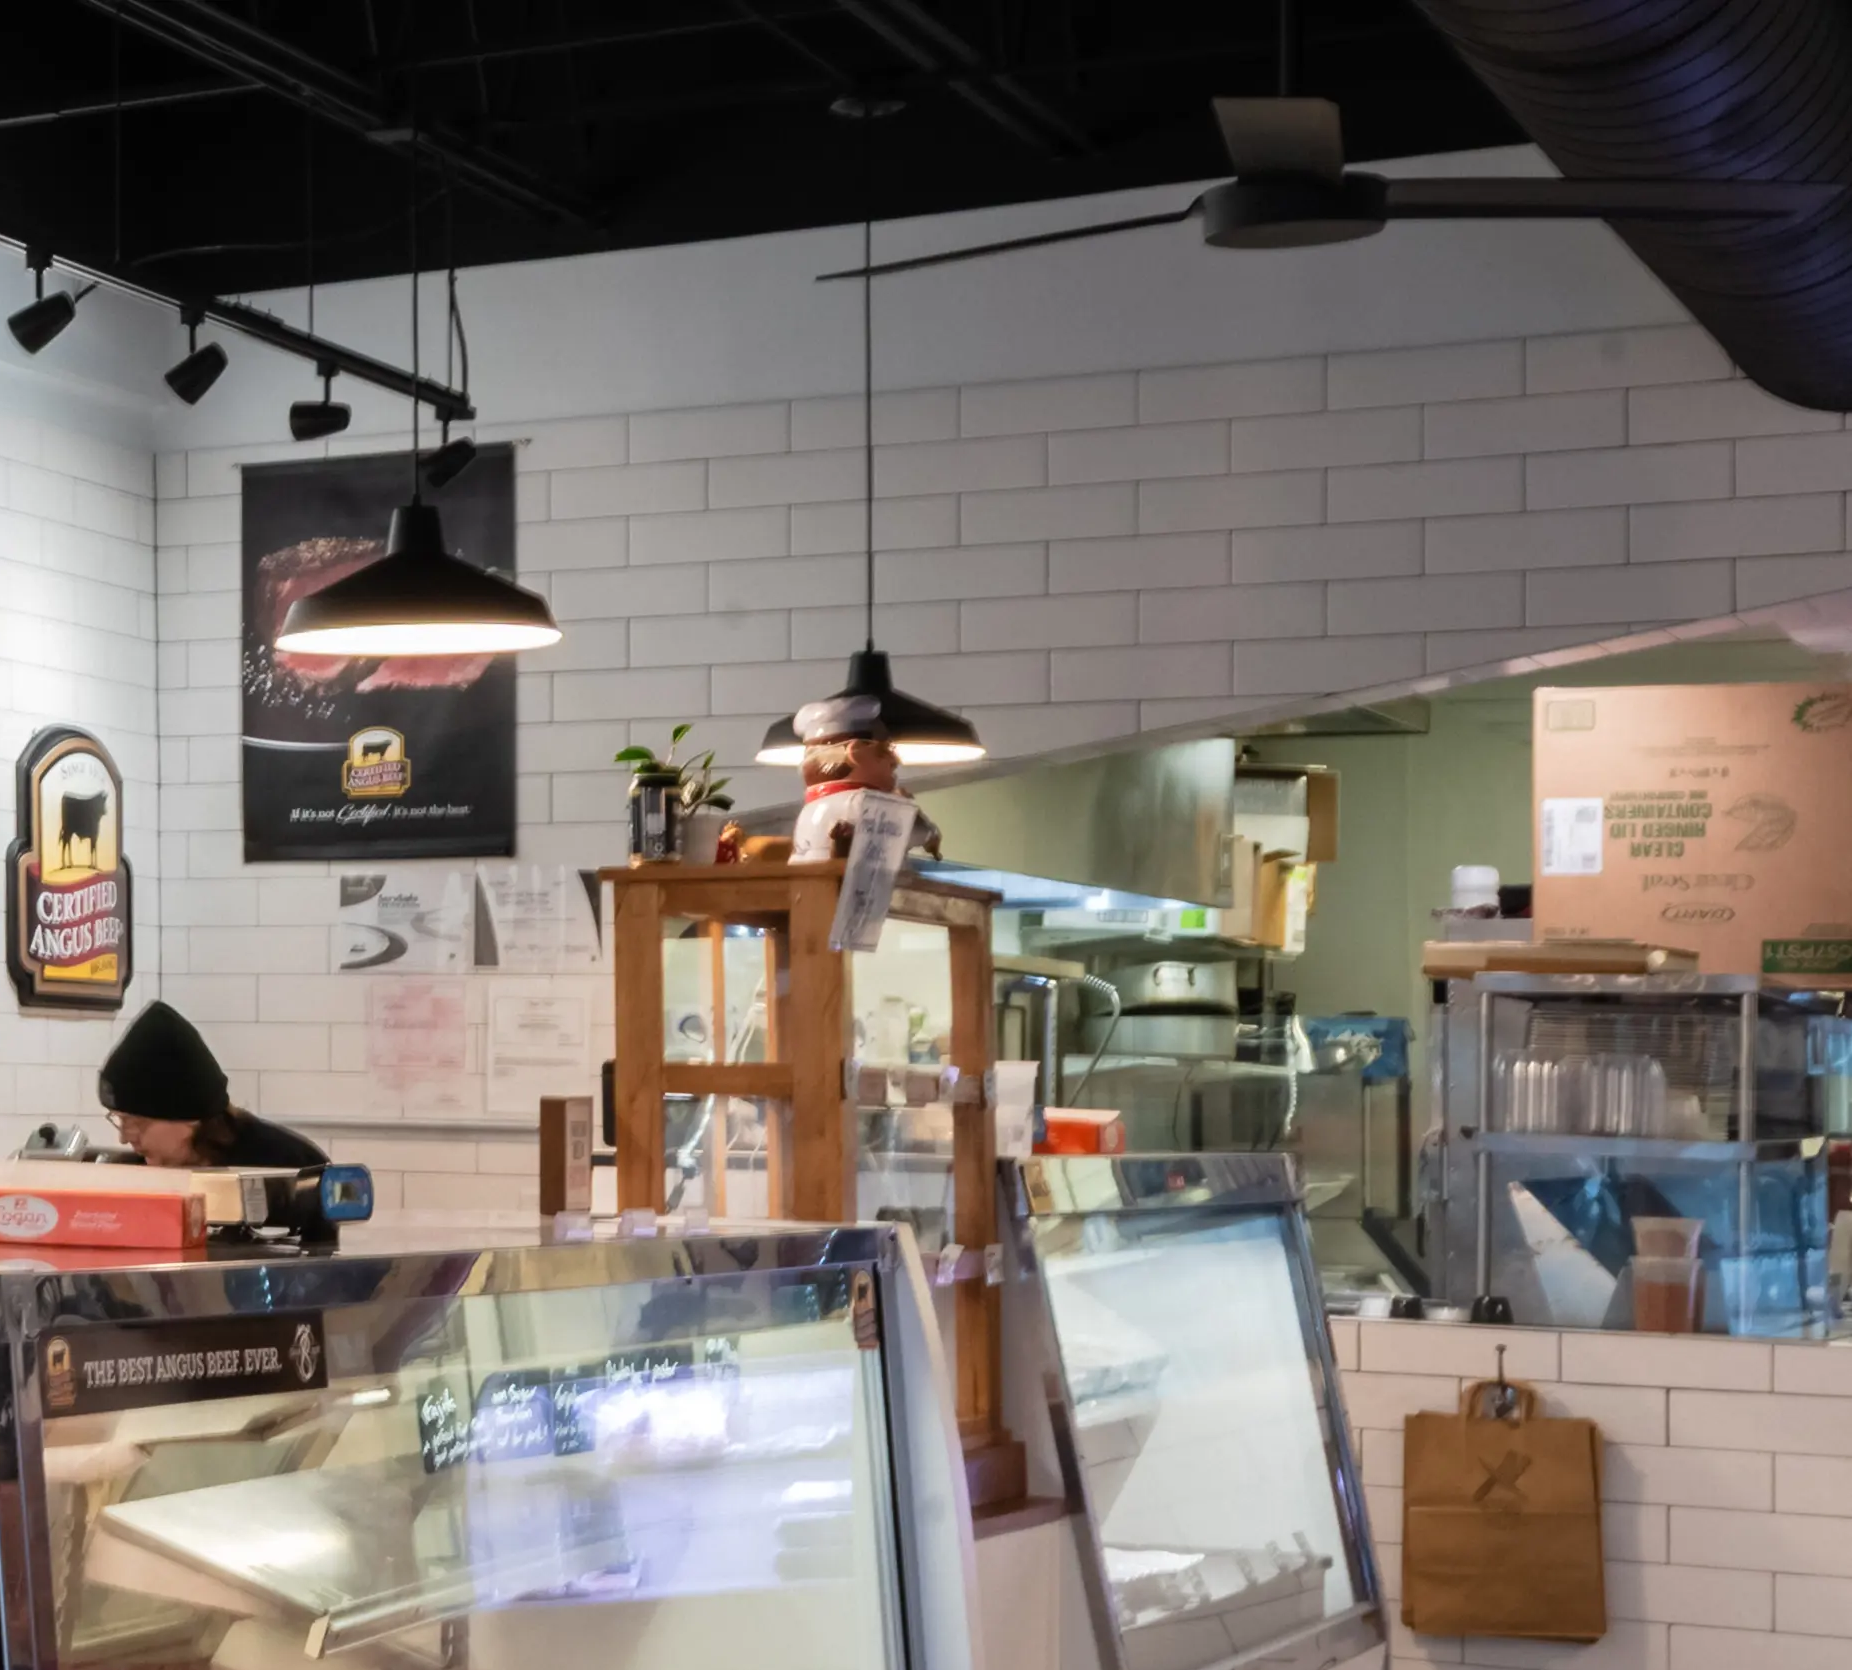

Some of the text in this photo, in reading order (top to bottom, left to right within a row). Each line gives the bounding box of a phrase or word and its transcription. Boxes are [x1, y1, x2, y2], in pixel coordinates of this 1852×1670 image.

[1630, 843, 1684, 858] CLEAR
[36, 882, 117, 924] CERTIFIED
[30, 917, 120, 959] ANGUS BEEF
[84, 1359, 116, 1388] THE
[118, 1355, 154, 1385] BEST
[156, 1353, 204, 1381] ANGUS
